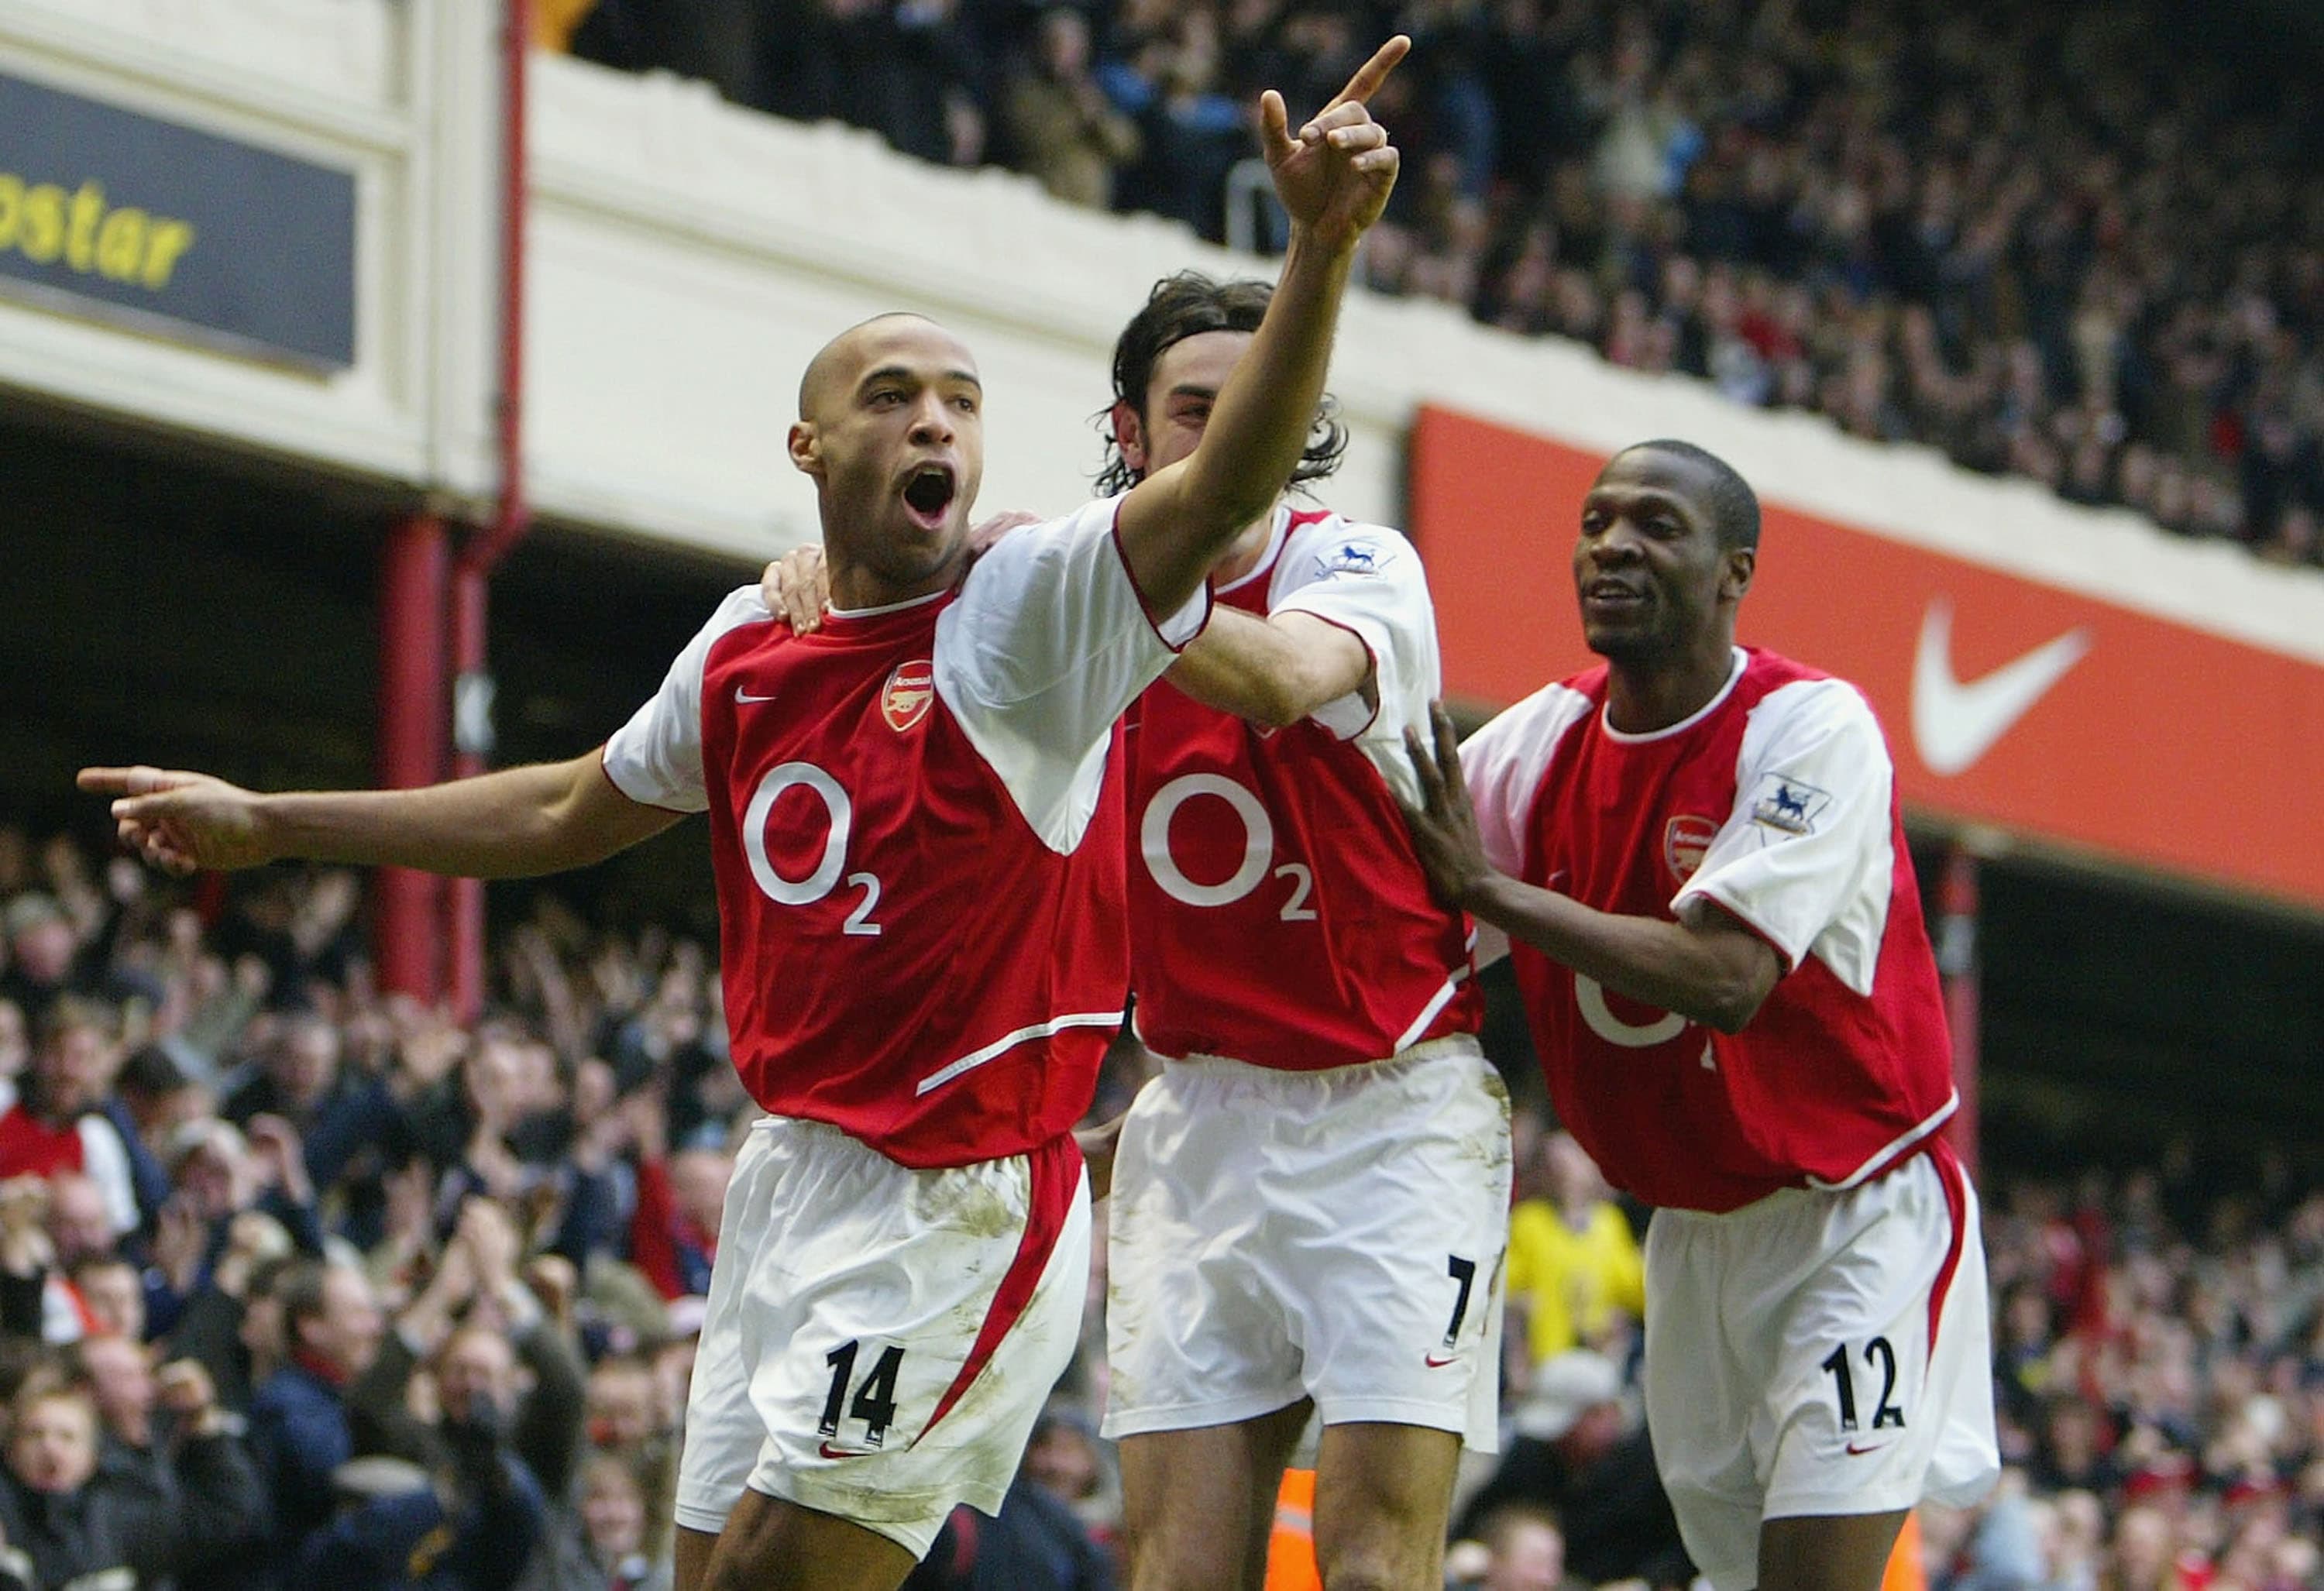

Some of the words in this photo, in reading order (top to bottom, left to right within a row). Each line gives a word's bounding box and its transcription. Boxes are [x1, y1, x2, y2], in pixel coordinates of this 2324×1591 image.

[1442, 1254, 1476, 1349] 7
[817, 1338, 906, 1447] 14
[1821, 1336, 1906, 1432] 12
